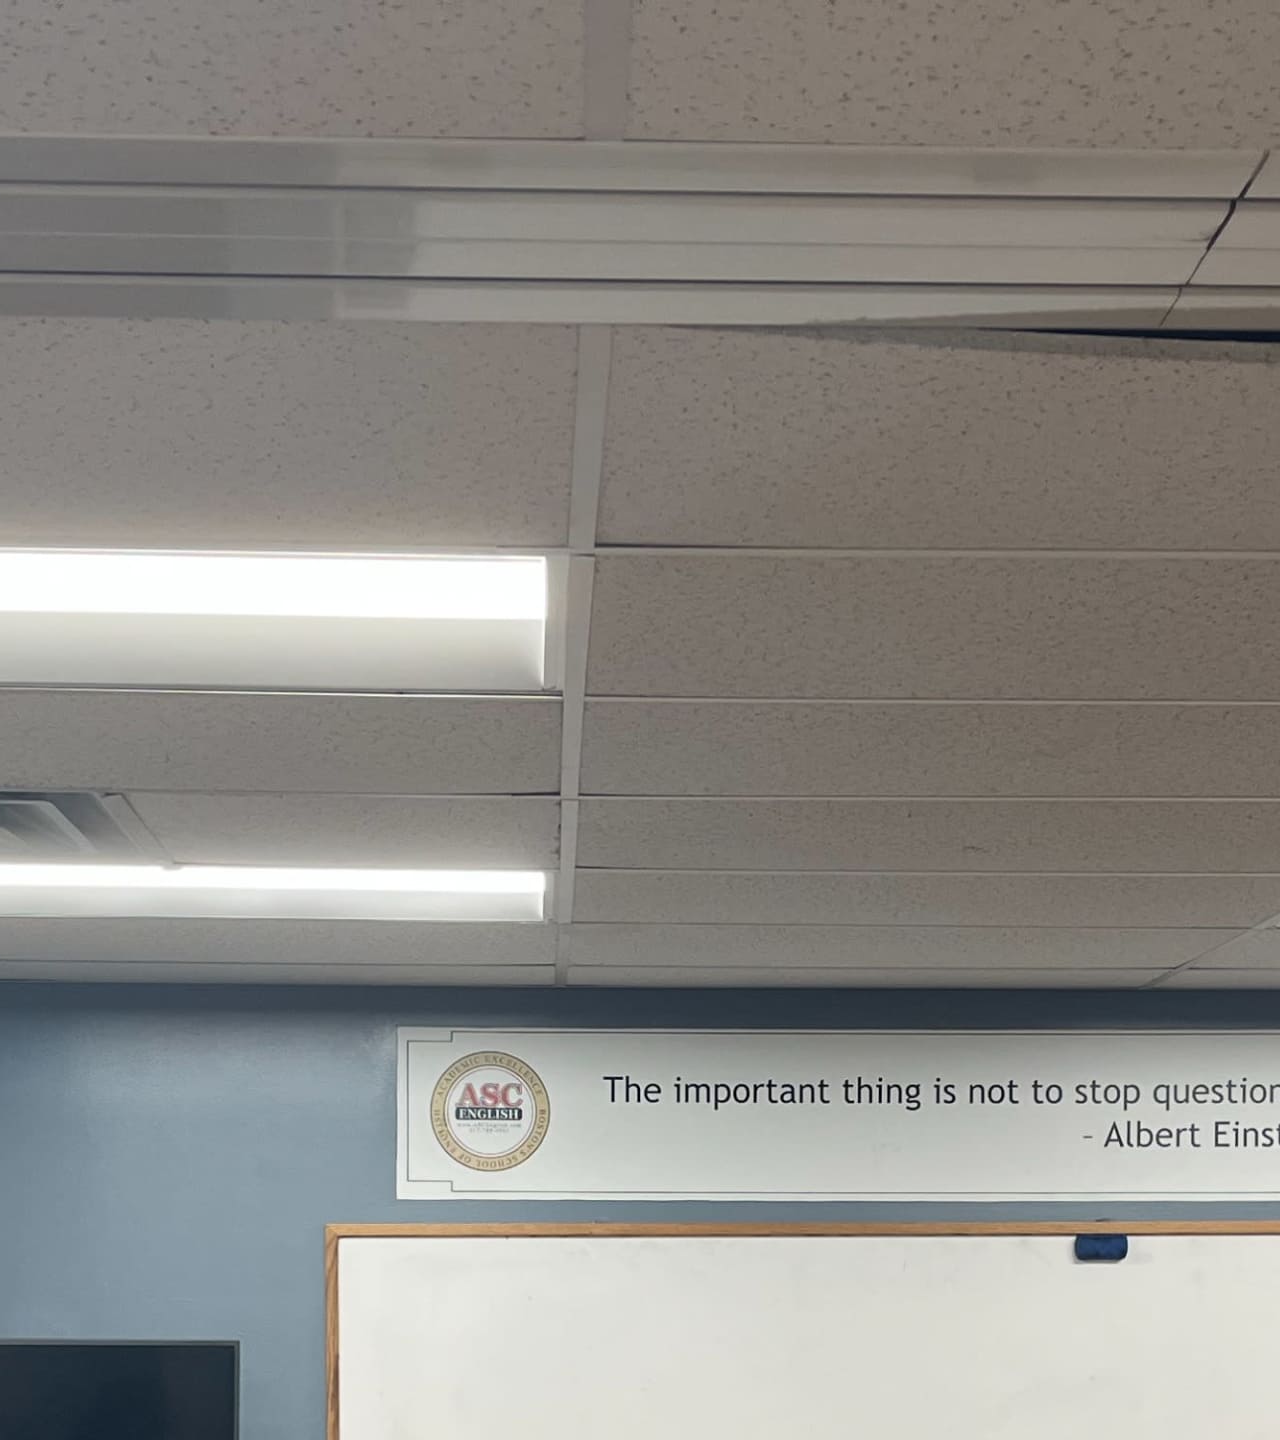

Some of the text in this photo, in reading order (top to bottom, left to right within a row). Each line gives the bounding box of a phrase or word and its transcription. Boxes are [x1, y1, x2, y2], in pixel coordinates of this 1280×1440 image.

[454, 1081, 524, 1107] ASC
[602, 1075, 662, 1104] The
[673, 1076, 831, 1111] important
[842, 1076, 922, 1112] thing
[933, 1077, 957, 1105] is
[969, 1079, 1020, 1105] not
[1031, 1079, 1063, 1105] to
[1074, 1079, 1141, 1112] stop
[458, 1108, 519, 1120] ENGLISH
[1103, 1120, 1201, 1148] Albert
